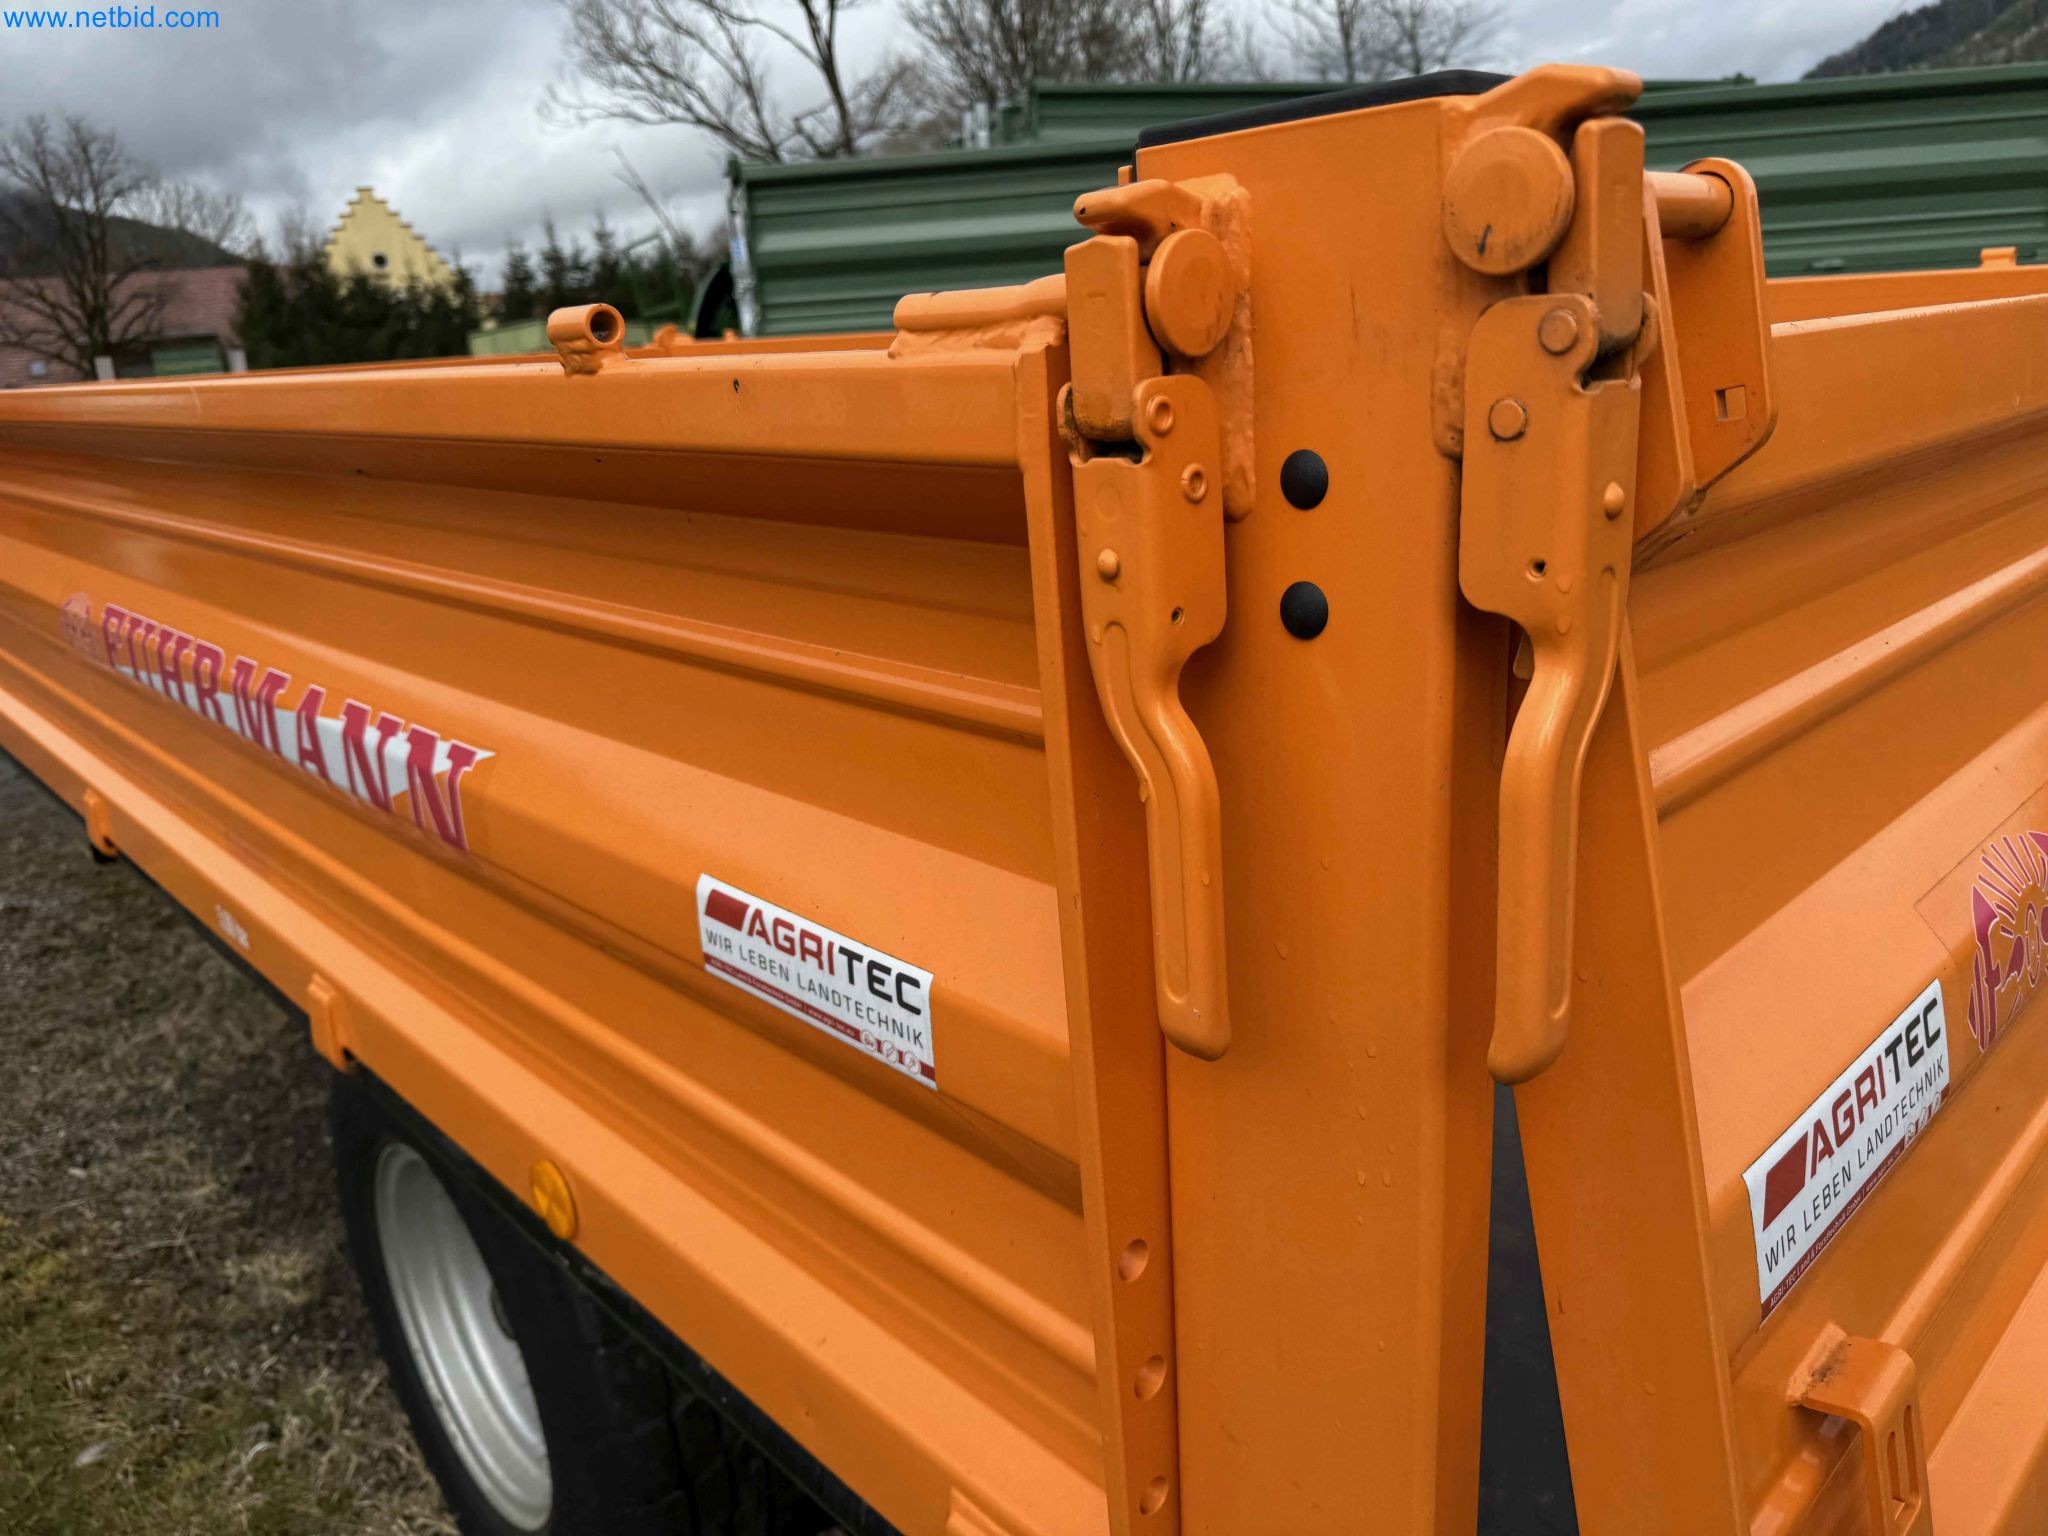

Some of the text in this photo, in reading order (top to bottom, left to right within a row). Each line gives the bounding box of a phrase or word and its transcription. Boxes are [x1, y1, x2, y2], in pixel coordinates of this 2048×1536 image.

[102, 602, 479, 851] FUHRMANN
[706, 928, 733, 955] WIR
[739, 945, 790, 982] LEBEN
[797, 972, 924, 1049] LANDTECHNIK
[747, 908, 922, 1016] AGRITEC
[1765, 1054, 1945, 1273] WIR LEBEN LANDTECHNIK
[1810, 997, 1942, 1180] AGRITEC
[1770, 1270, 1797, 1308] AGRI-TEC
